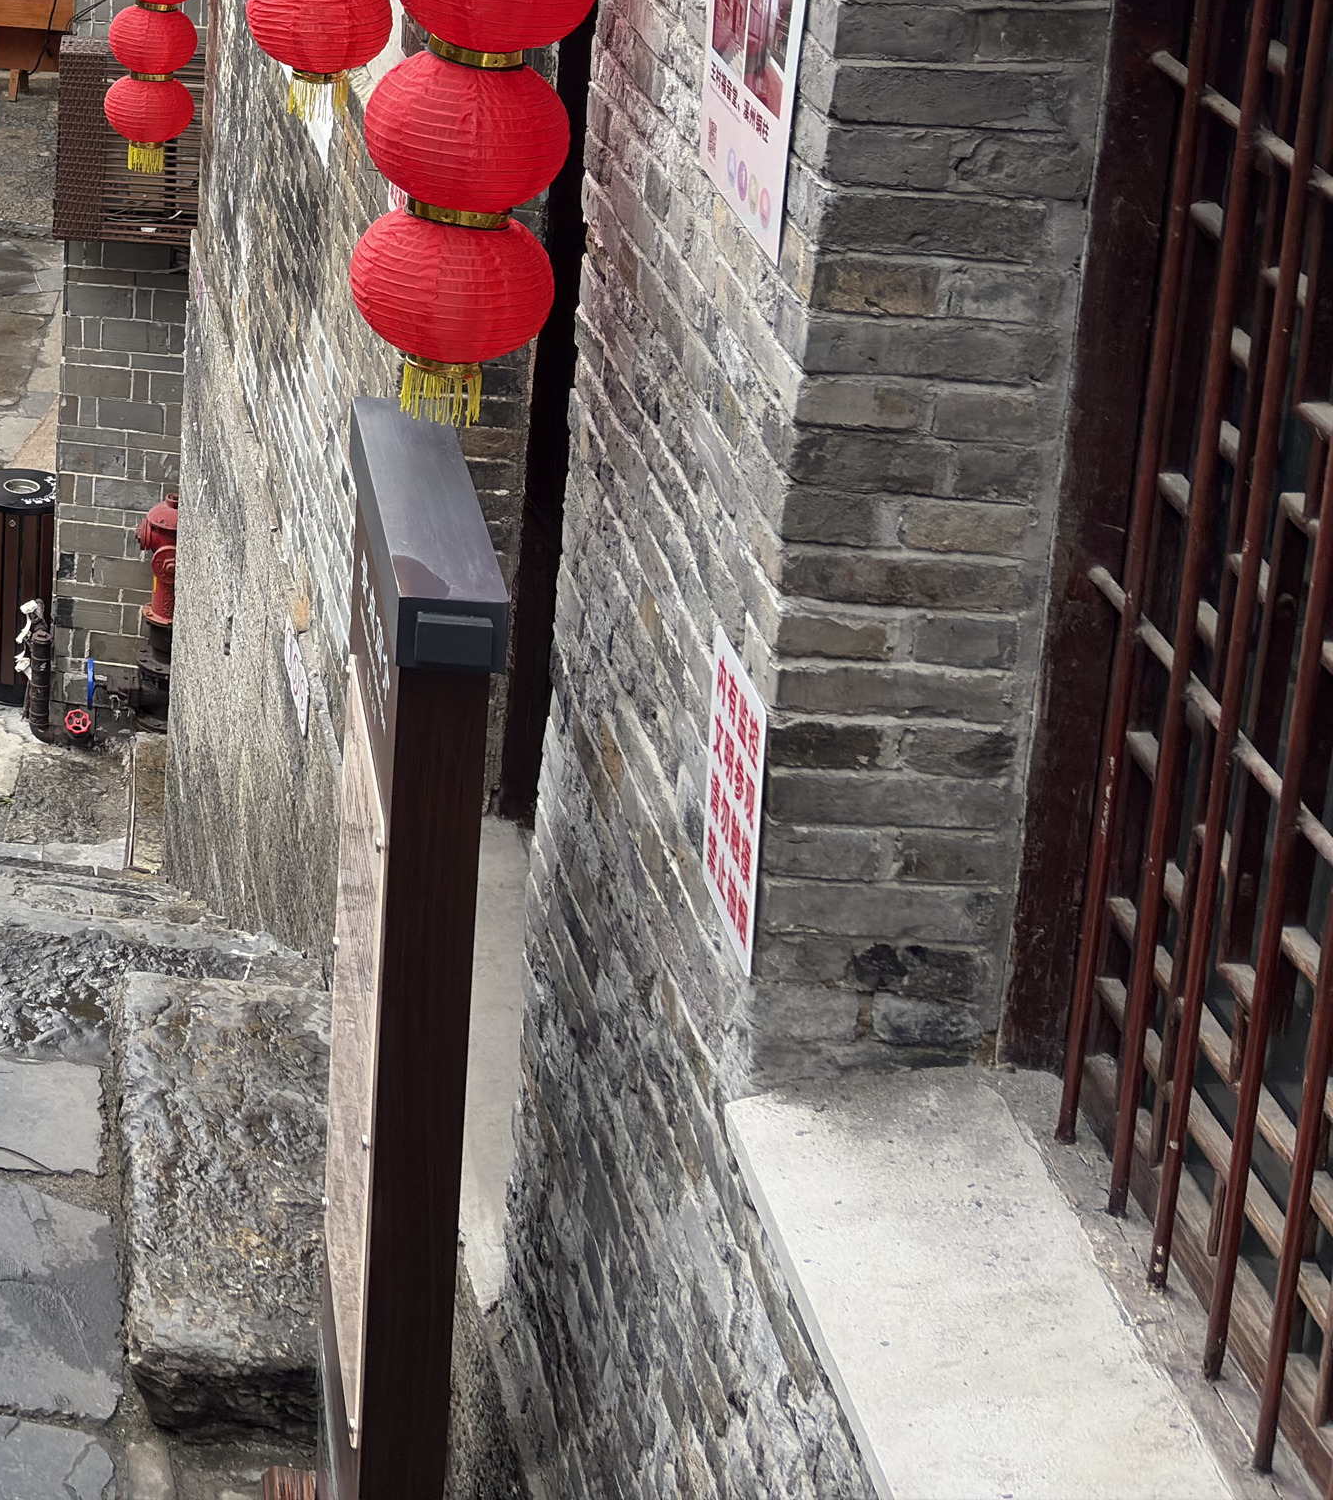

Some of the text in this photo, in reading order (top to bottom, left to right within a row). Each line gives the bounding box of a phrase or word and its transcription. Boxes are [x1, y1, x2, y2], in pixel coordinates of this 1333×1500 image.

[712, 713, 756, 832] 文明参观
[716, 654, 760, 772] 内有监控
[707, 824, 749, 951] 禁止抽烟
[710, 767, 752, 891] 请勿触摸
